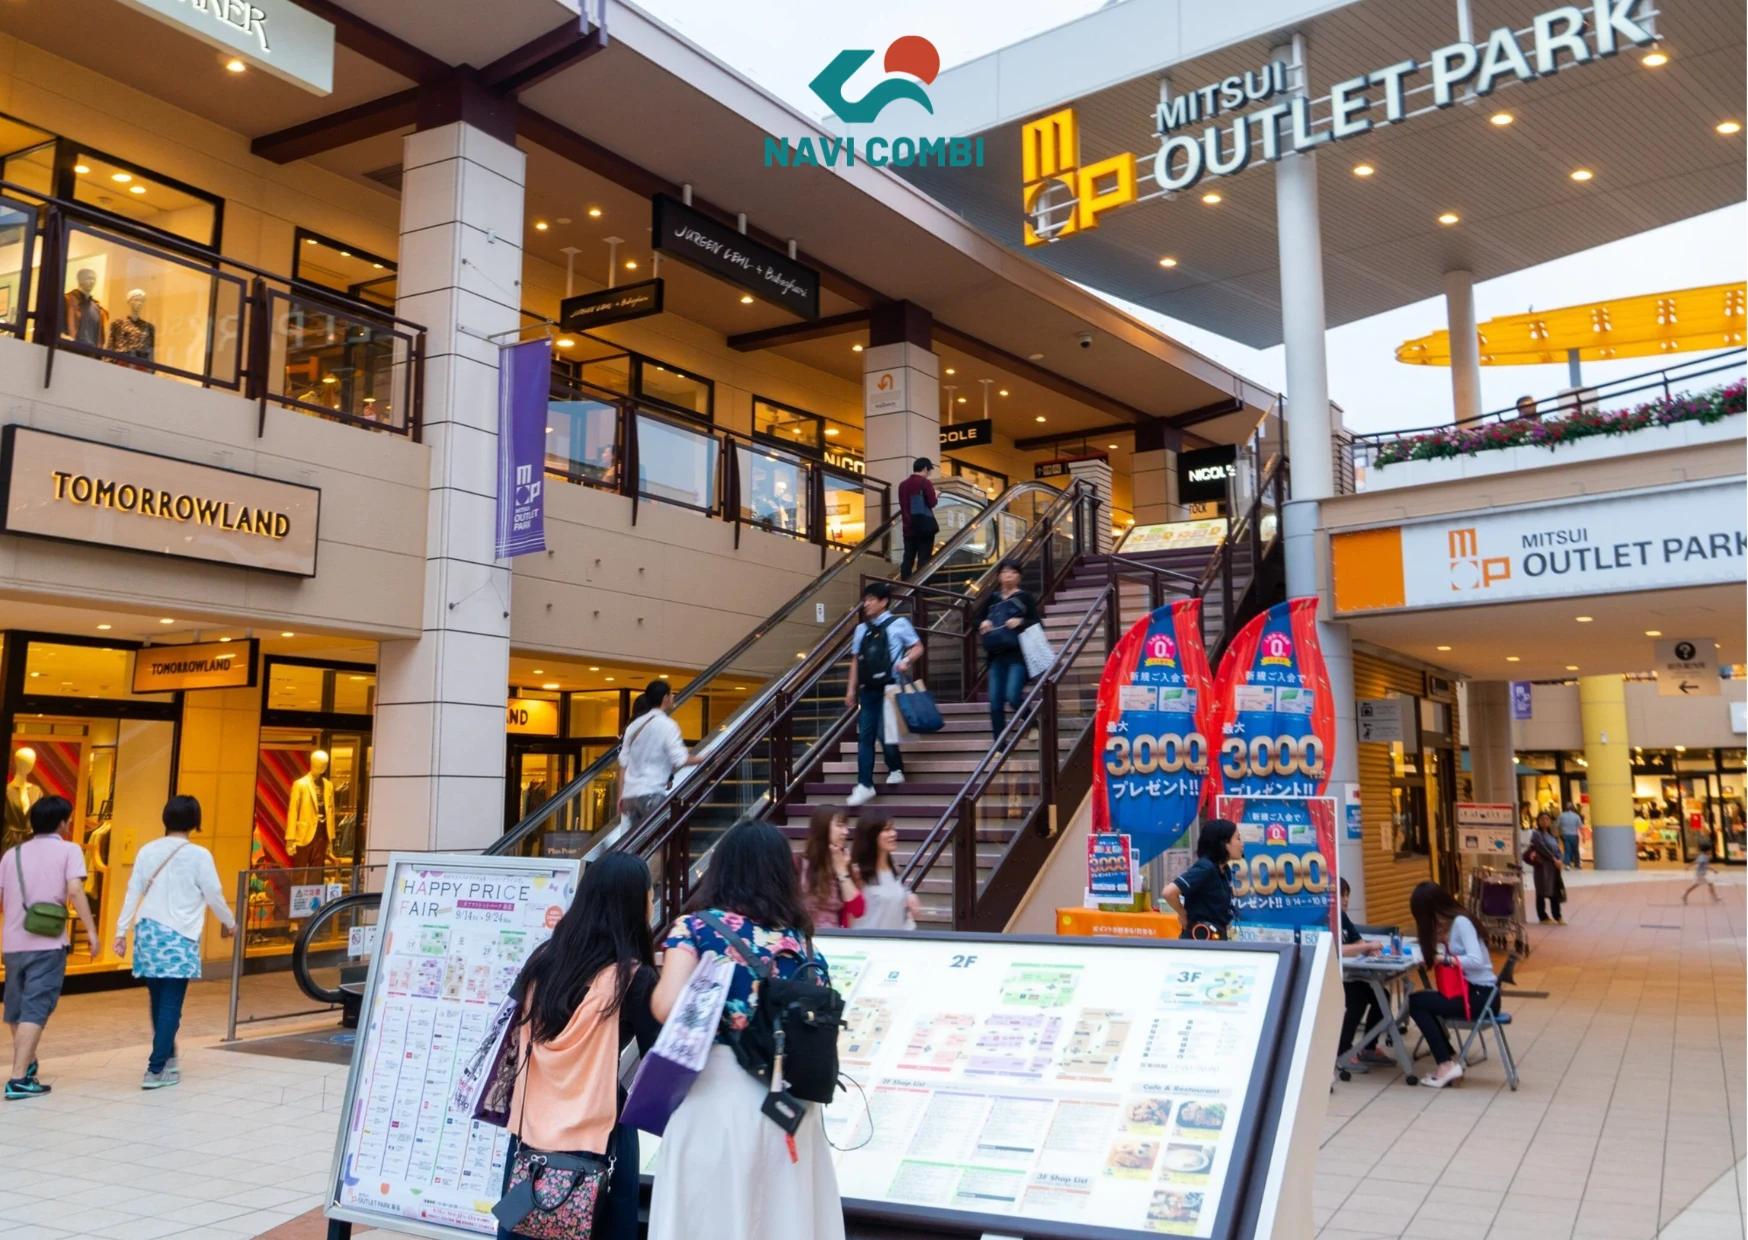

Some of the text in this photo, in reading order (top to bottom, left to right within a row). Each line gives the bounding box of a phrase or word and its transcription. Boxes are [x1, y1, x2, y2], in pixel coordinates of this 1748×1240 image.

[1153, 0, 1658, 192] OUTLET PARK
[1156, 58, 1288, 134] MITSUI
[51, 470, 291, 539] TOMORROWLAND
[514, 508, 539, 523] OUTLET
[513, 520, 531, 531] PARK
[1521, 527, 1588, 550] MITSUI
[1522, 541, 1653, 578] OUTLET
[152, 659, 231, 675] TOMORROWLAND
[1106, 721, 1129, 733] 最大
[1222, 722, 1245, 734] 最大
[1105, 732, 1207, 777] 3,000
[1222, 734, 1324, 780] 3,000
[403, 879, 530, 901] HAPPY PRICE
[400, 901, 439, 917] FAIR
[949, 954, 978, 968] 2F
[1176, 971, 1202, 983] 3F
